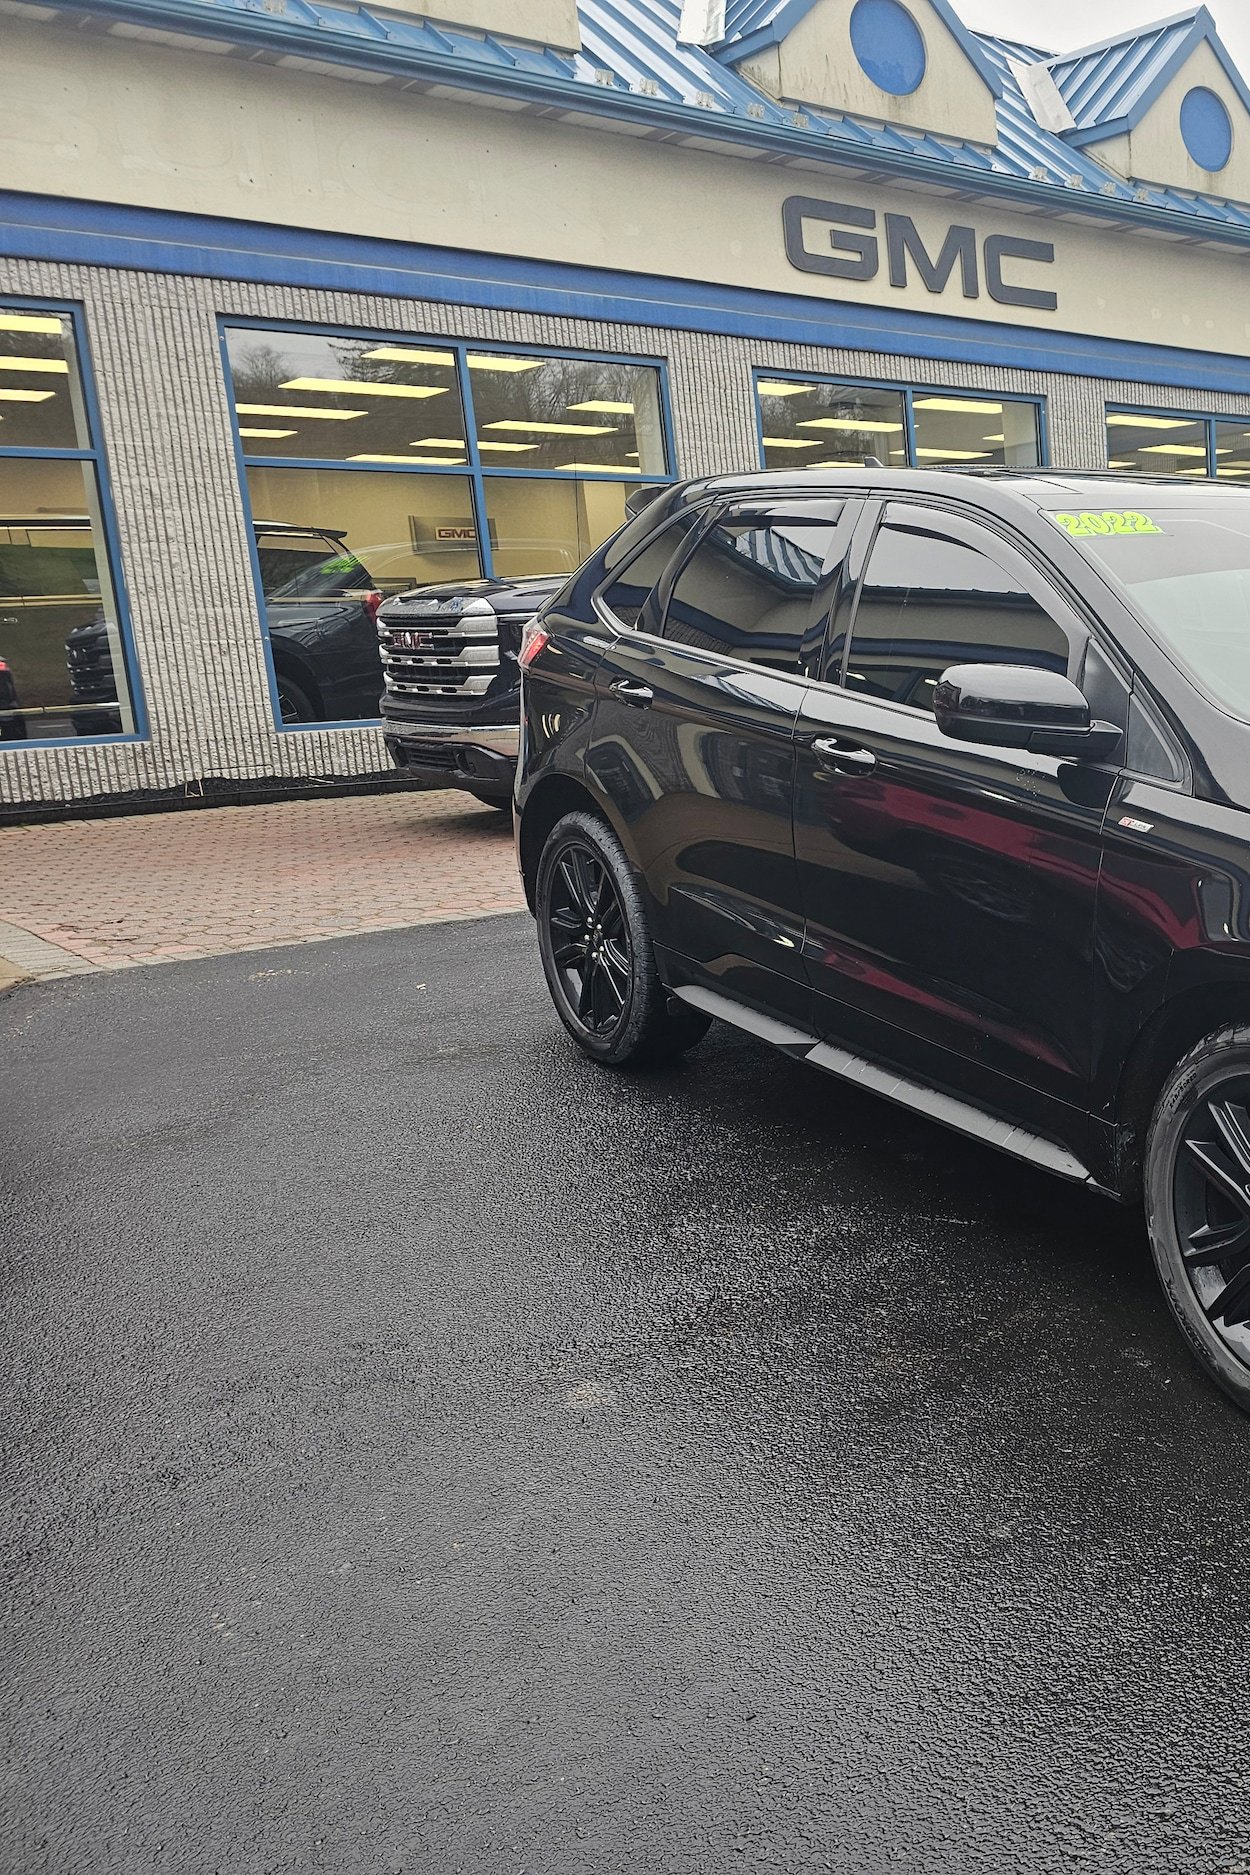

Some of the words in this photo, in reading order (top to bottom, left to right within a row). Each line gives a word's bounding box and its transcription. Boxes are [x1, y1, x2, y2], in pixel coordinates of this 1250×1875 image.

[782, 195, 1058, 310] GMC
[438, 528, 476, 538] GMC
[1056, 511, 1160, 536] 2022
